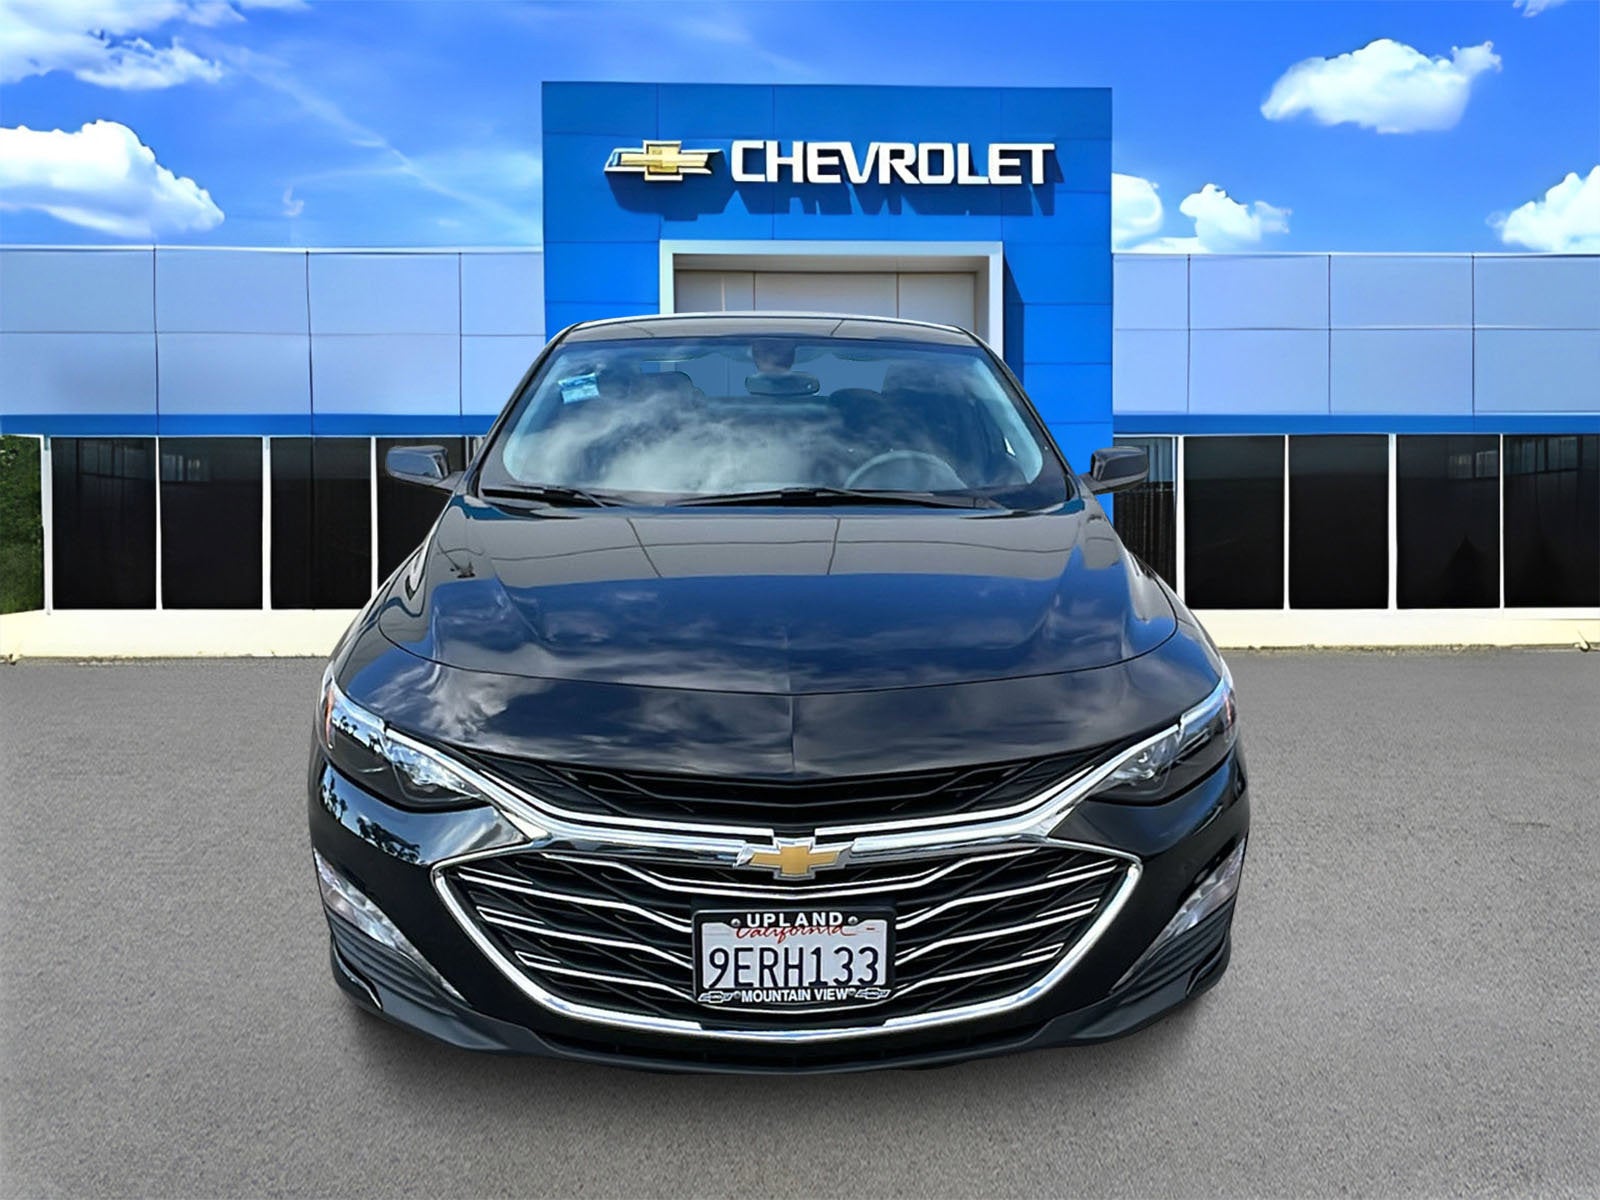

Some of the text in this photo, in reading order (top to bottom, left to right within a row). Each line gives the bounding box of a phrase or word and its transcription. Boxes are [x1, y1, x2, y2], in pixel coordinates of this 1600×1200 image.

[731, 140, 1055, 185] CHEVROLET
[746, 912, 843, 927] UPLAND
[709, 946, 879, 988] 9ERH133
[741, 990, 811, 1002] MOUNTAIN
[814, 988, 850, 1001] VIEW
